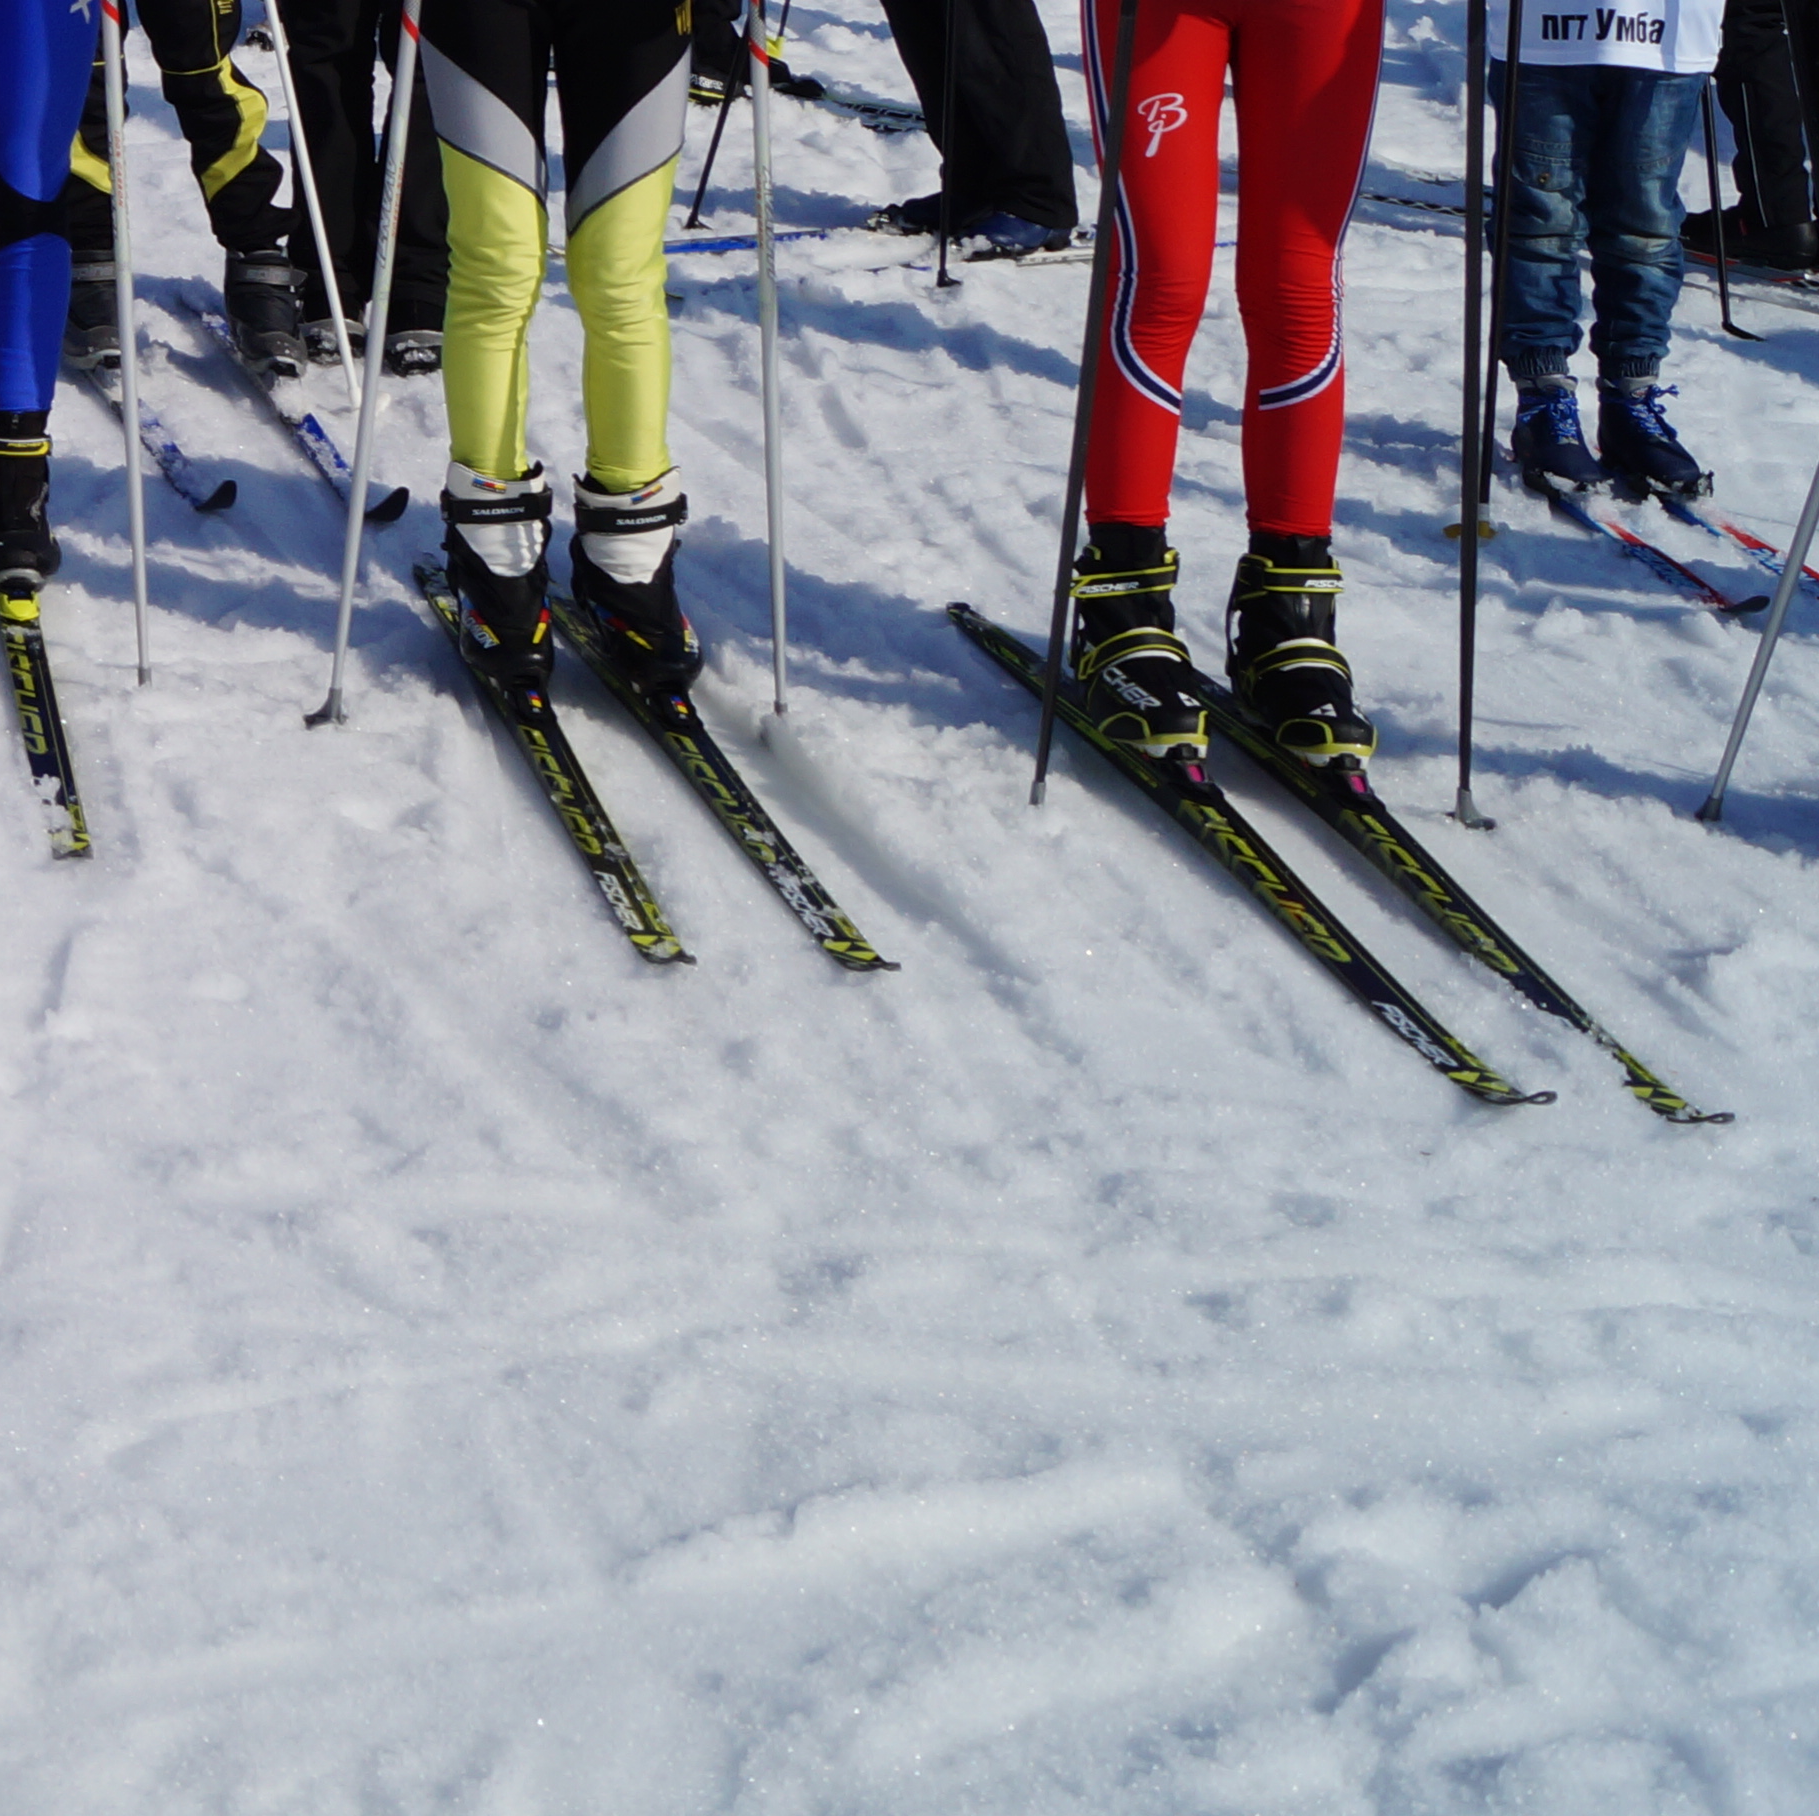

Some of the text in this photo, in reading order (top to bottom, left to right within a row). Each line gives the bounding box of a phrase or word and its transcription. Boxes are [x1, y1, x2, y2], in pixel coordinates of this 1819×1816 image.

[1542, 8, 1665, 44] пгт Умба
[471, 505, 525, 517] SALOMON
[615, 513, 667, 526] SALOMON
[1102, 666, 1163, 712] CHER
[594, 870, 643, 932] FISCHER
[1373, 1000, 1459, 1068] FISCHER
